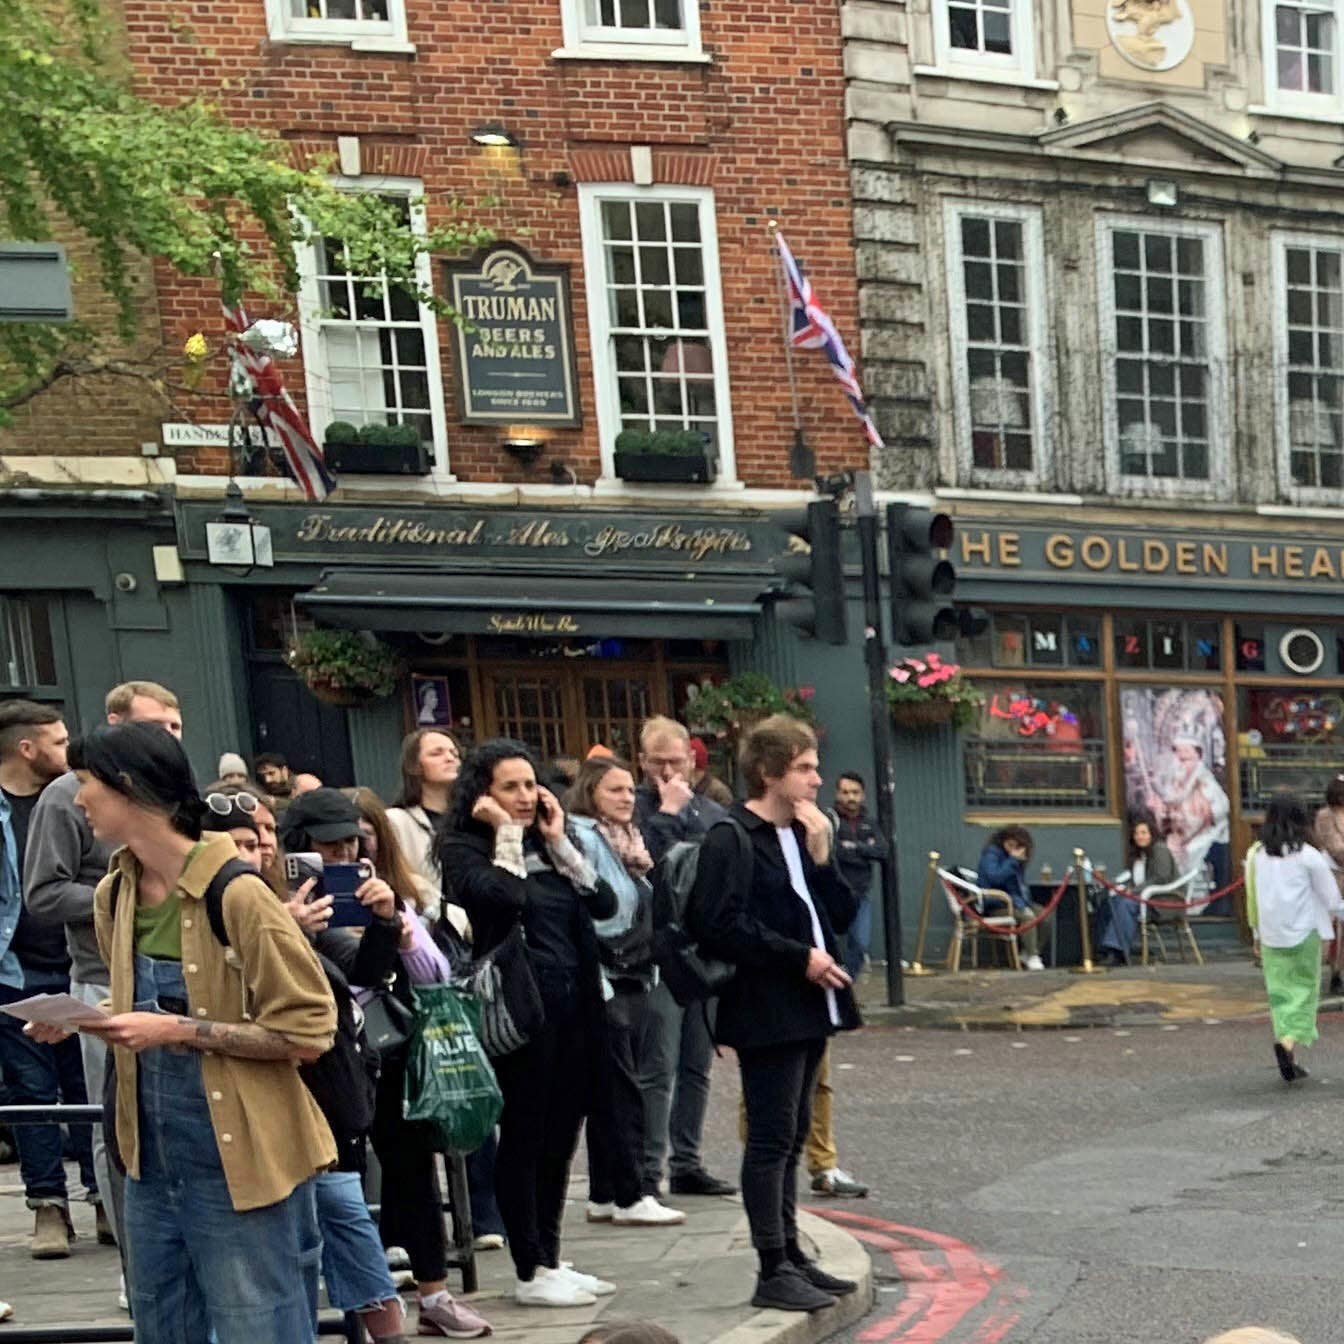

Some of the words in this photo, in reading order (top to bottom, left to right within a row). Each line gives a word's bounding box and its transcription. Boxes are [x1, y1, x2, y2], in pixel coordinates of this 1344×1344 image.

[463, 295, 555, 321] TRUMAN
[479, 328, 545, 343] BEERS
[472, 344, 507, 358] AND
[510, 345, 556, 360] ALES
[297, 513, 487, 545] Traditional
[1045, 534, 1229, 574] GOLDEN
